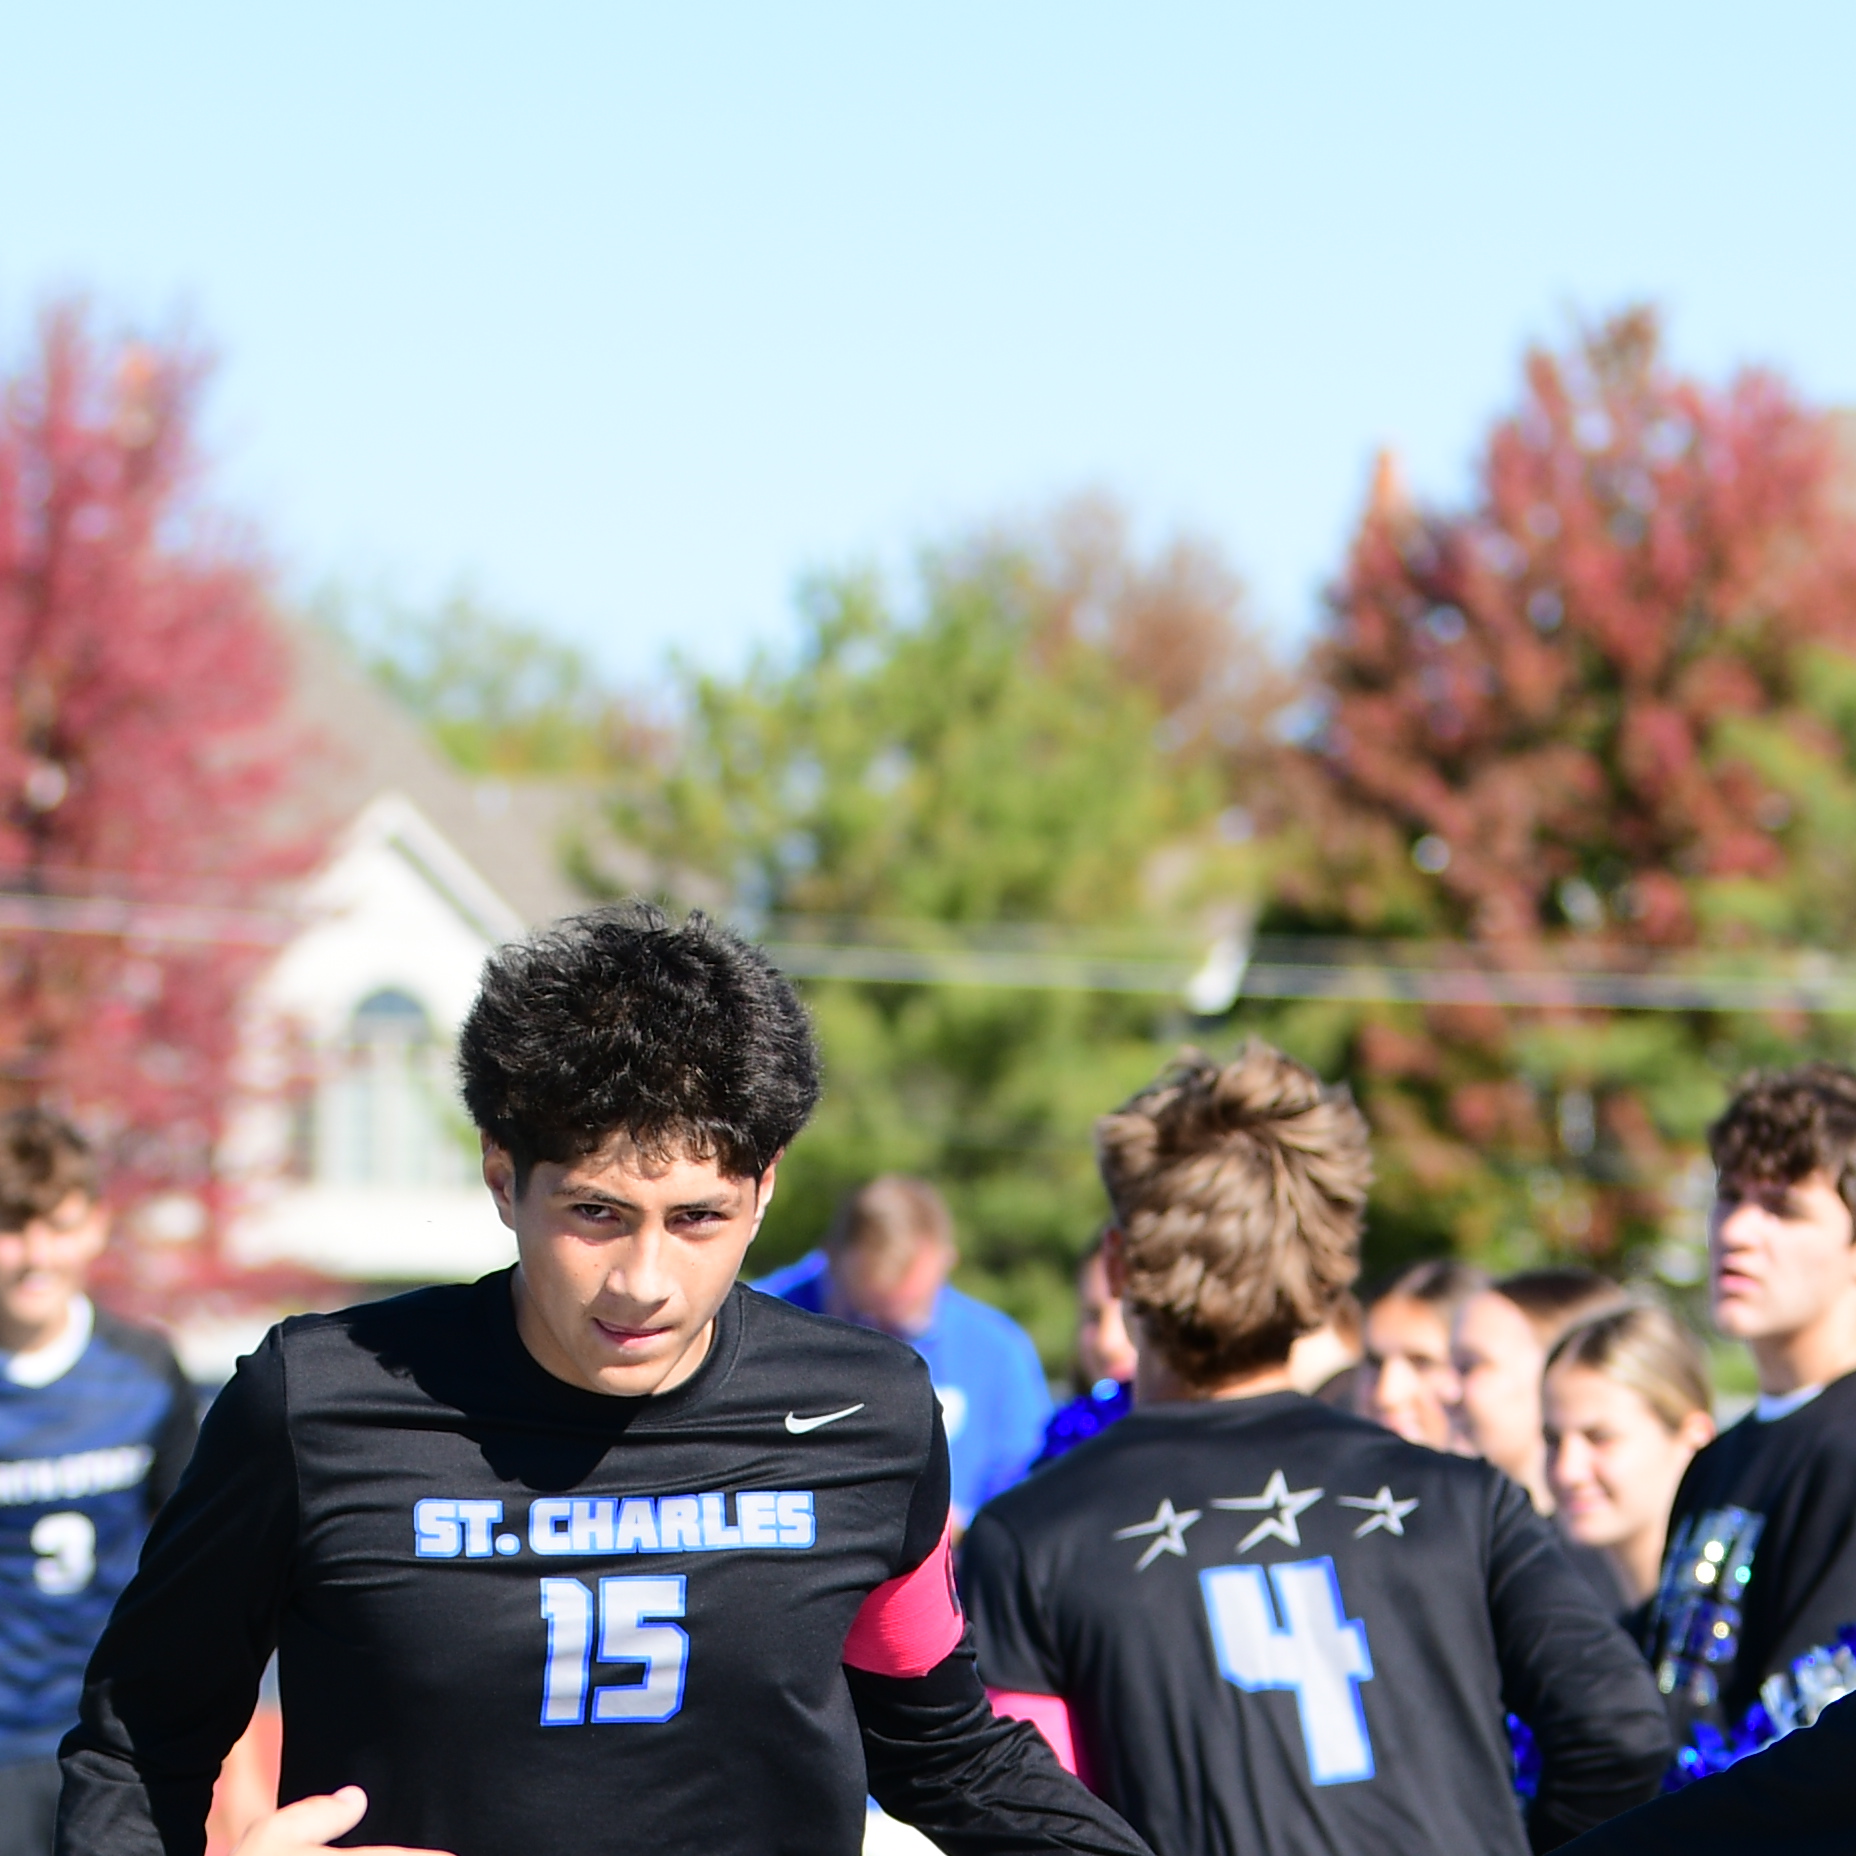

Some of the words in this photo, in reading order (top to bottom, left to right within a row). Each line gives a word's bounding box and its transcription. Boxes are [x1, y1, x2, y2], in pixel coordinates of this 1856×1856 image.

[31, 1512, 97, 1596] 3
[414, 1498, 520, 1557] ST.
[529, 1491, 817, 1556] CHARLES
[540, 1575, 690, 1726] 15
[1199, 1556, 1376, 1787] 4
